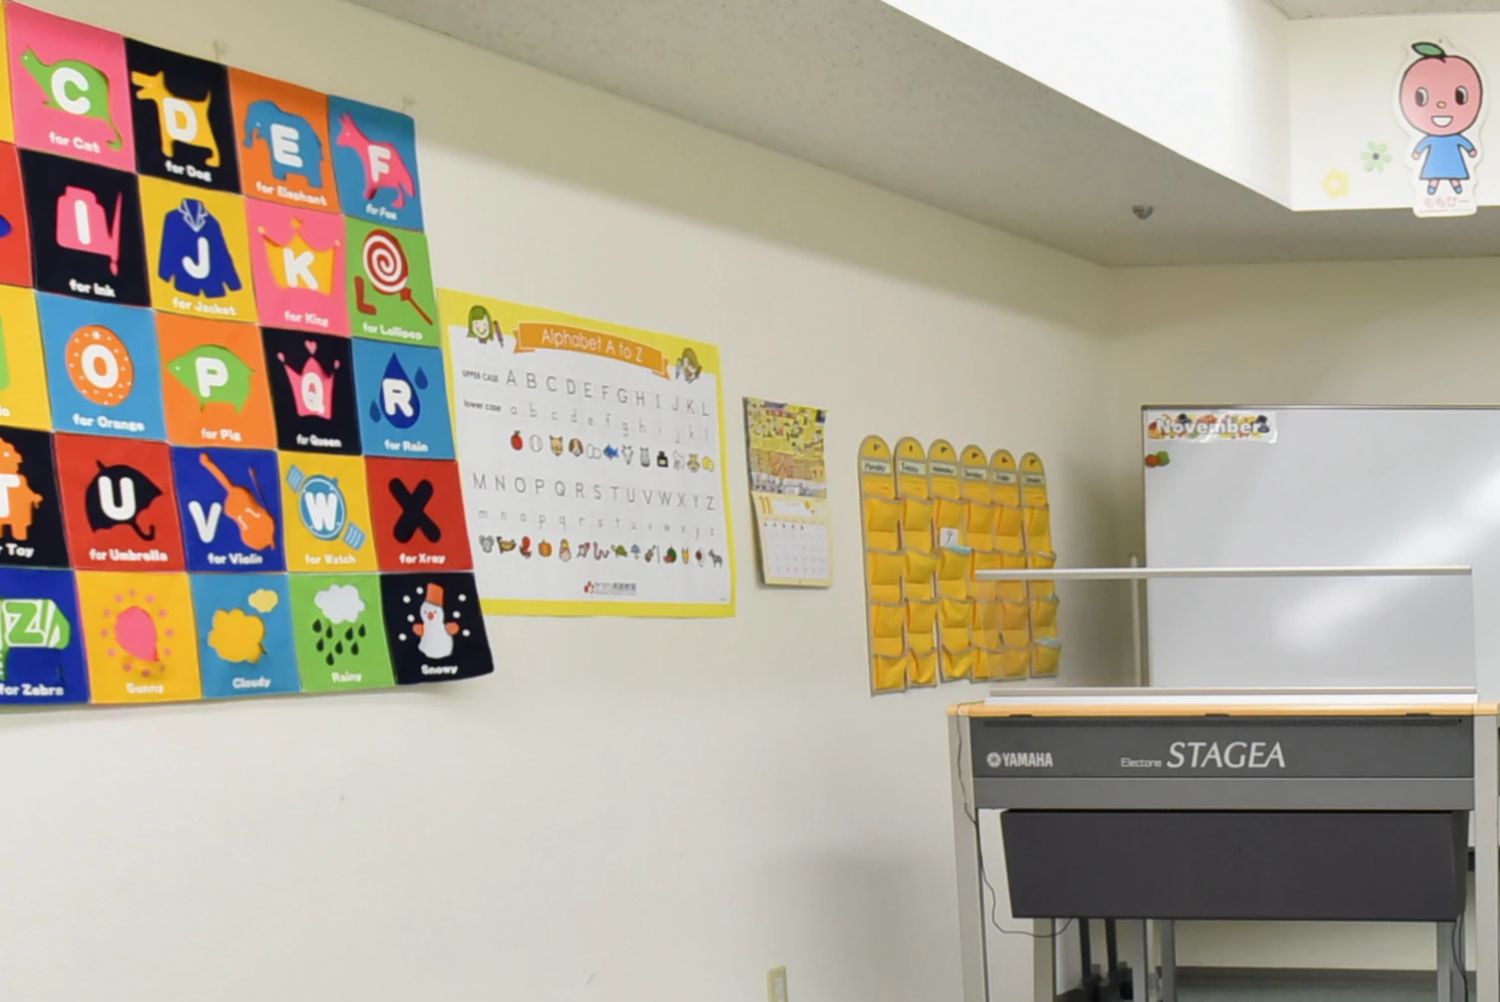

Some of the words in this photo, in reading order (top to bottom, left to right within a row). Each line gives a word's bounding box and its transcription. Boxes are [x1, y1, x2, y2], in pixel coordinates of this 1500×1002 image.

[51, 67, 91, 115] C
[163, 97, 198, 142] D
[48, 130, 70, 146] for
[72, 137, 101, 154] Cat
[270, 123, 303, 168] E
[165, 160, 185, 175] for
[186, 164, 213, 183] Dog
[367, 144, 391, 183] F
[255, 180, 275, 195] for
[276, 185, 328, 207] Elephant
[74, 199, 92, 246] I
[379, 205, 398, 221] Fox
[182, 236, 211, 279] J
[282, 247, 319, 291] K
[68, 278, 92, 294] for
[93, 282, 116, 298] Ink
[354, 275, 377, 315] L
[172, 296, 193, 311] for
[194, 300, 237, 317] Jacket
[283, 310, 304, 323] for
[304, 311, 329, 328] King
[362, 322, 378, 334] for
[380, 324, 423, 341] Lollipop
[542, 328, 601, 351] Alphabet
[606, 338, 617, 353] A
[620, 341, 632, 359] to
[635, 346, 645, 362] Z
[81, 343, 119, 389] O
[195, 357, 229, 398] P
[301, 372, 325, 415] Q
[382, 378, 414, 418] R
[506, 369, 517, 386] A
[525, 372, 537, 389] B
[546, 375, 558, 392] C
[566, 379, 576, 395] D
[584, 382, 593, 398] E
[602, 385, 609, 400] F
[617, 388, 628, 404] G
[635, 391, 645, 406] H
[673, 397, 679, 411] J
[686, 399, 695, 415] K
[702, 401, 710, 417] L
[72, 413, 95, 428] for
[97, 415, 145, 432] Orange
[201, 427, 217, 440] for
[219, 429, 242, 442] Pig
[1156, 417, 1262, 434] November
[310, 434, 342, 449] Queen
[384, 439, 401, 451] for
[402, 440, 429, 452] Rain
[98, 475, 137, 521] U
[472, 472, 487, 490] M
[495, 475, 506, 492] N
[514, 476, 526, 494] O
[535, 479, 545, 494] P
[554, 480, 566, 497] Q
[575, 482, 584, 498] R
[593, 484, 602, 500] S
[609, 486, 620, 501] T
[626, 488, 636, 503] U
[642, 489, 653, 505] V
[658, 491, 672, 506] W
[677, 492, 687, 508] X
[692, 494, 700, 509] Y
[706, 495, 715, 511] Z
[188, 500, 222, 544] V
[304, 491, 338, 531] W
[388, 477, 442, 544] X
[5, 543, 35, 559] Toy
[89, 548, 108, 561] for
[108, 549, 168, 562] Umbrella
[207, 552, 227, 565] for
[228, 552, 263, 565] Violin
[305, 553, 323, 565] for
[324, 553, 356, 565] Watch
[399, 553, 417, 564] for
[419, 553, 446, 565] Xray
[3, 600, 45, 646] Z
[331, 671, 363, 684] Rainy
[420, 664, 458, 676] Snowy
[21, 683, 64, 696] Zebra
[126, 682, 164, 695] Sunny
[232, 676, 272, 689] Cloudy
[1002, 752, 1053, 767] YAMAHA
[1121, 757, 1162, 767] Electone
[1167, 741, 1286, 768] STAGEA
